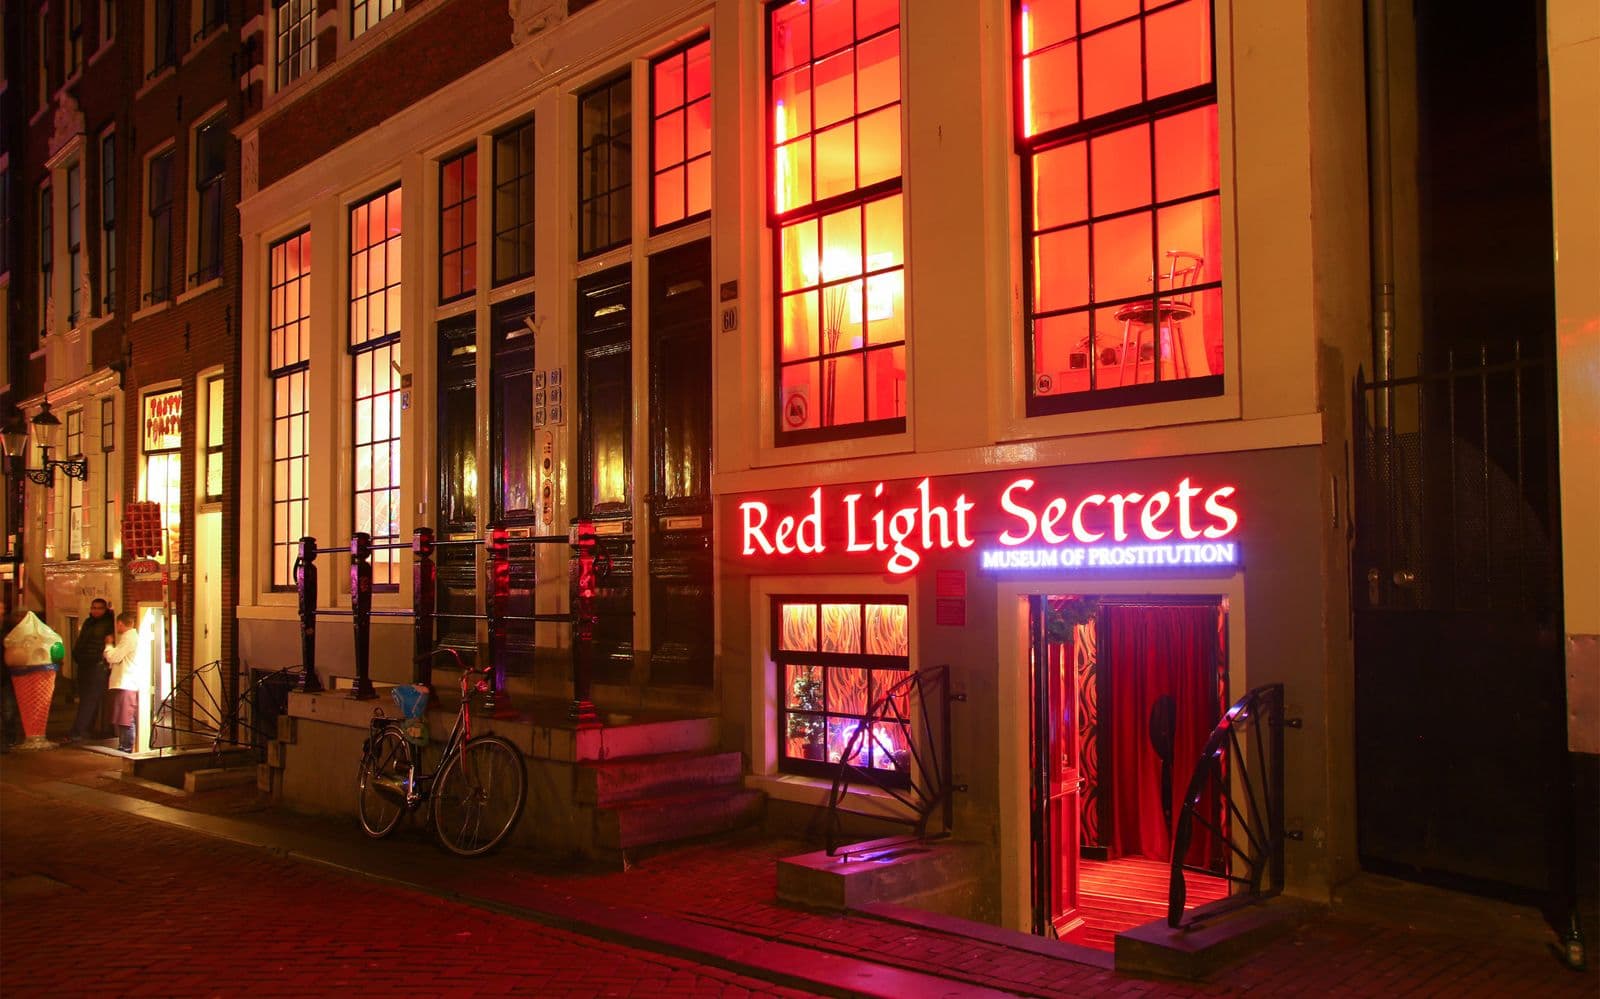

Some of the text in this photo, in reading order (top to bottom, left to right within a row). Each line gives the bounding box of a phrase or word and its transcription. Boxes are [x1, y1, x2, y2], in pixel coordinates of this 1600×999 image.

[723, 310, 735, 329] 60
[150, 393, 181, 418] TASTY
[738, 477, 1238, 574] Red Light Secrets
[983, 543, 1234, 569] MUSEUM OF PROSTITUTION
